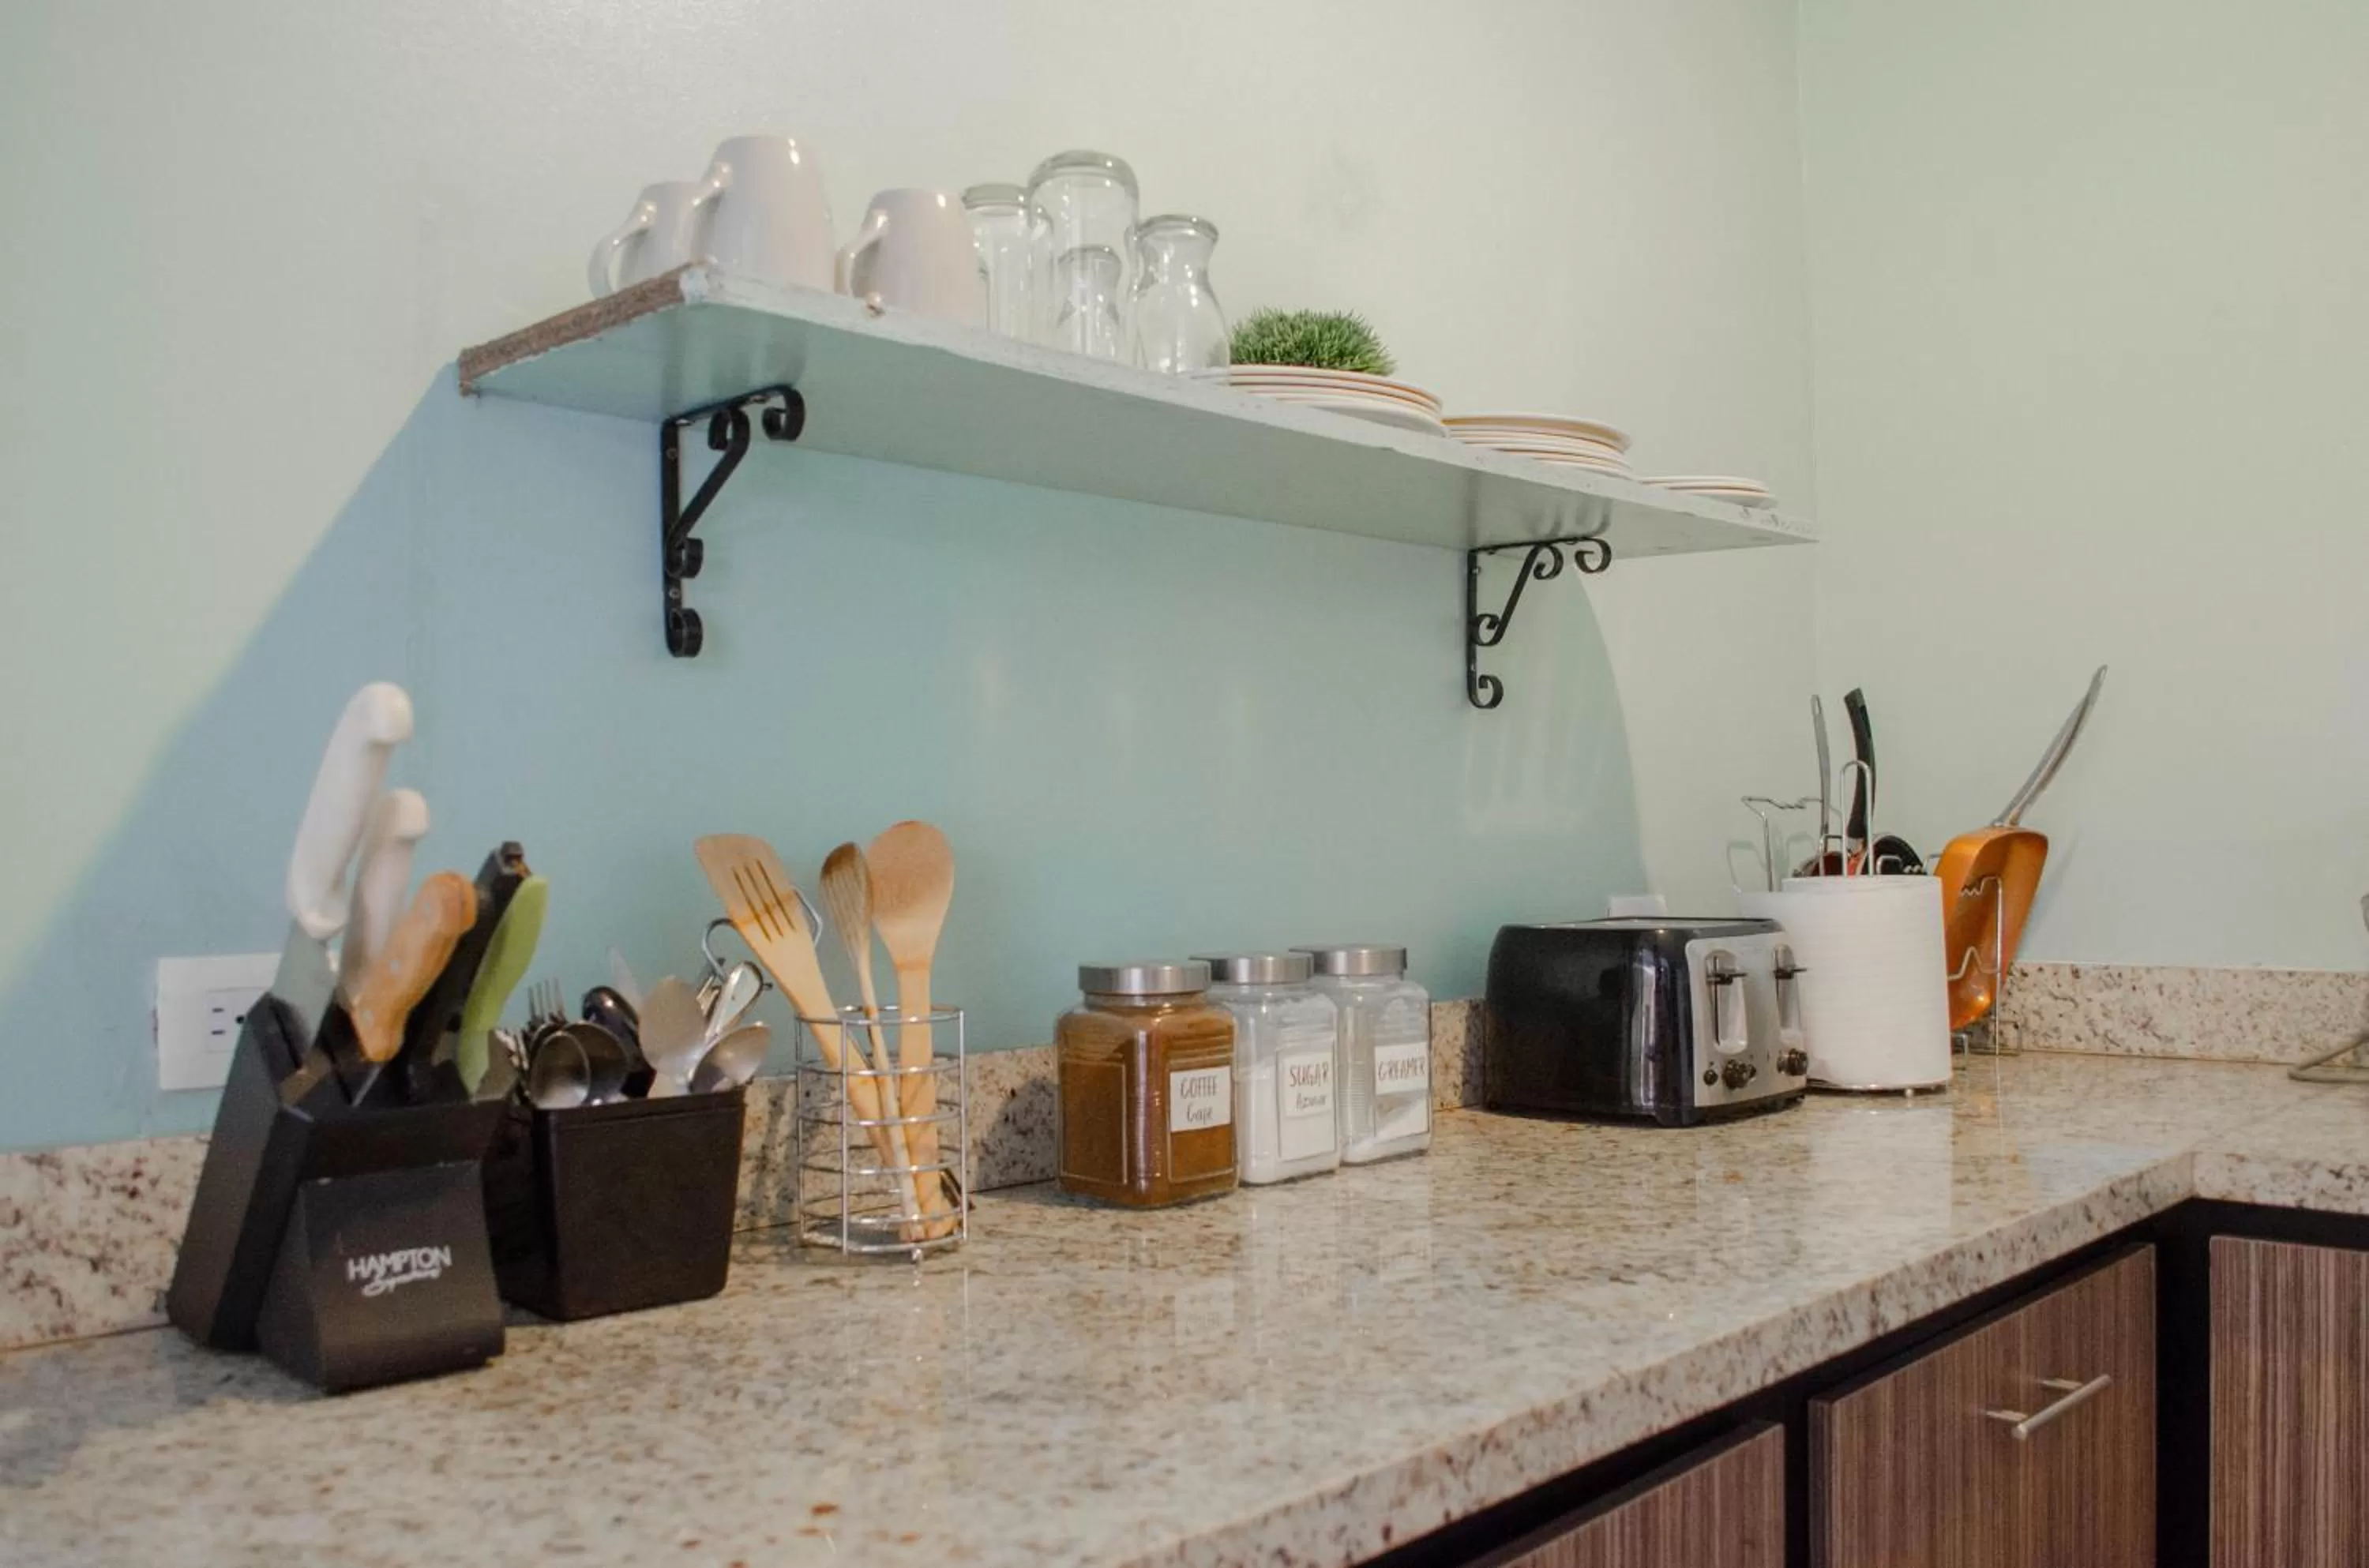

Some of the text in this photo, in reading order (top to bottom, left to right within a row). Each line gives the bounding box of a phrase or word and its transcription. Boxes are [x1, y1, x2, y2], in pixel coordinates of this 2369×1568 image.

[1289, 1060, 1329, 1087] SUGAR
[1180, 1075, 1218, 1100] COFFEE
[347, 1244, 452, 1281] HAMPTON
